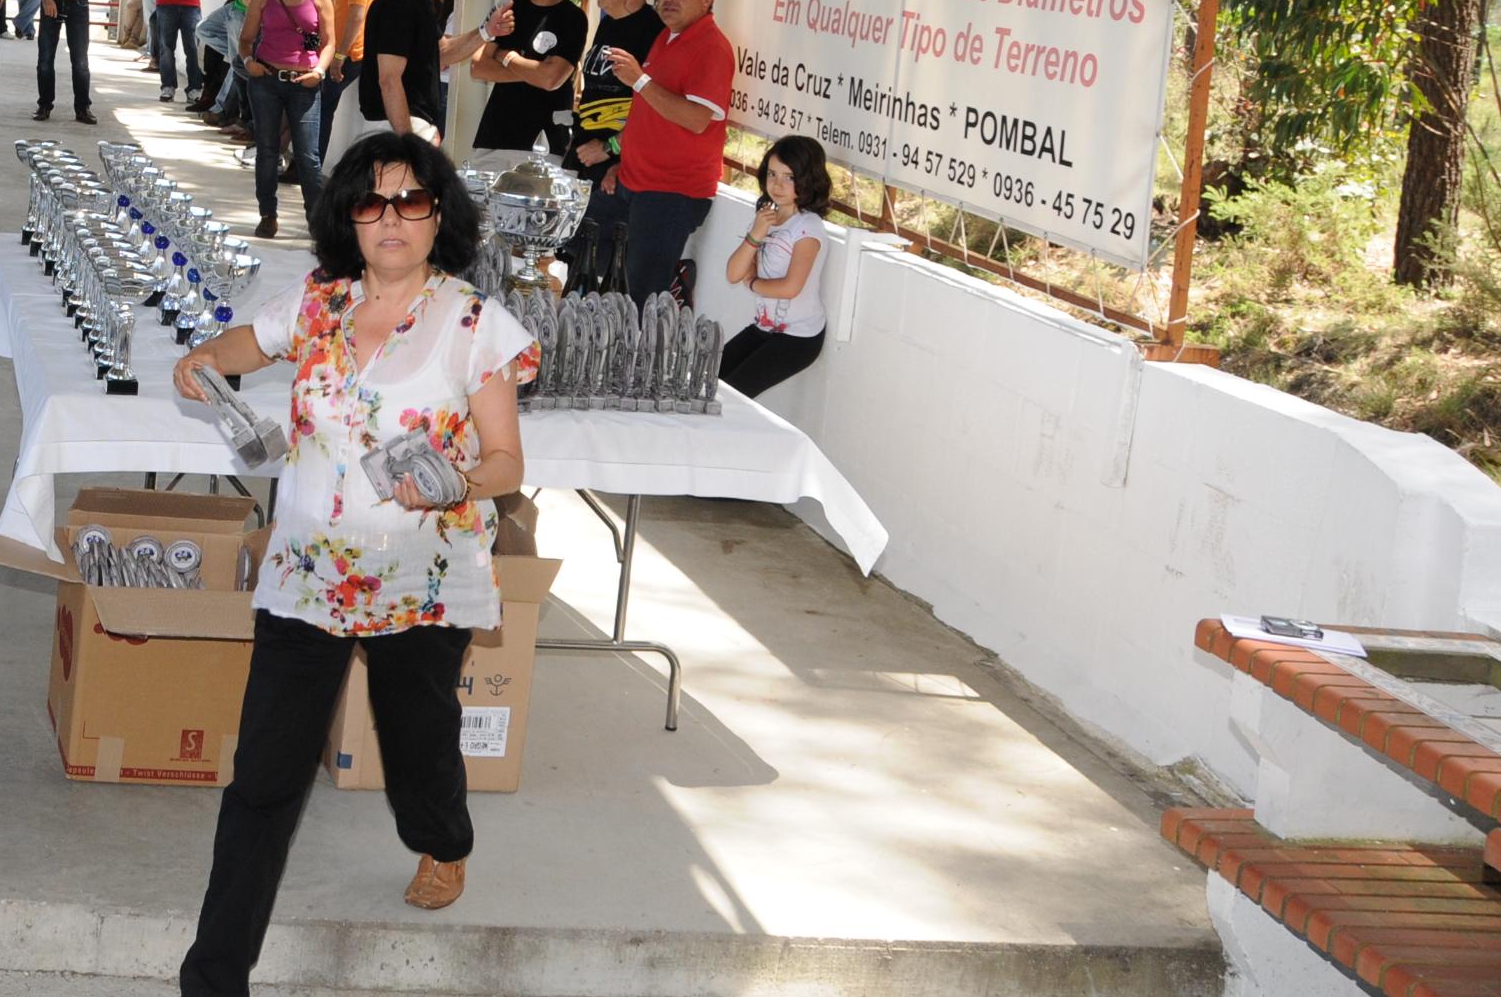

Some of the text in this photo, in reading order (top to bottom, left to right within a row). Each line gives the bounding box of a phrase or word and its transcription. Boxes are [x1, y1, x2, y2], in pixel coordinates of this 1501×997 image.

[737, 46, 1073, 168] Vale da Cruz Meirinhas POMBAL
[900, 10, 947, 63] Tipo
[953, 22, 984, 65] de
[994, 26, 1098, 88] Terreno
[757, 98, 770, 120] 94
[773, 103, 787, 125] 82
[790, 108, 804, 131] 57
[816, 117, 854, 150] Telem.
[858, 131, 887, 160] 0931
[902, 144, 919, 170] 94
[925, 150, 943, 176] 57
[947, 158, 976, 188] 529
[993, 172, 1034, 207] 0936
[1052, 190, 1075, 219] 45
[1081, 197, 1104, 229] 75
[1110, 208, 1135, 240] 29
